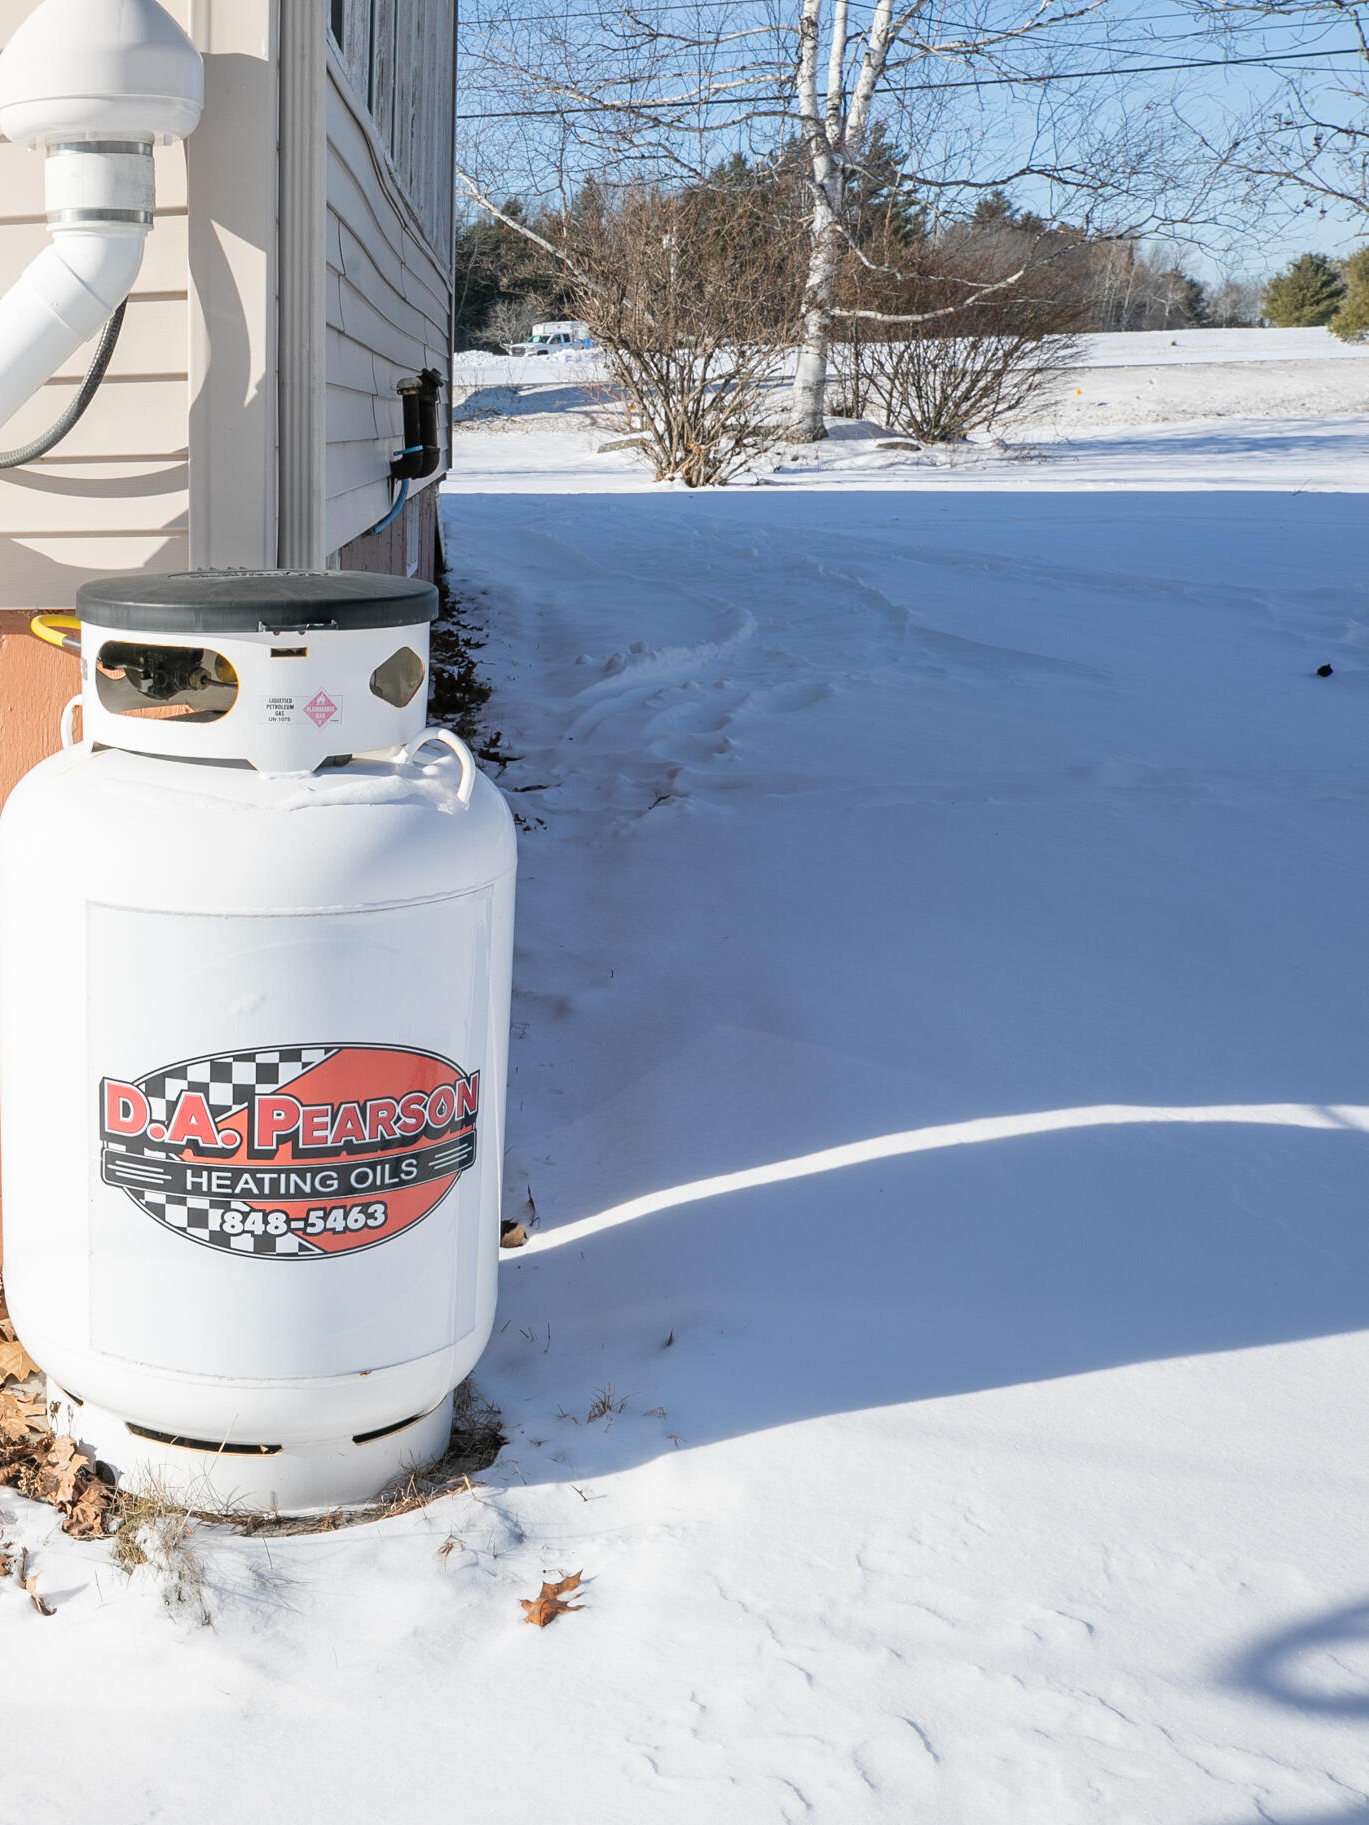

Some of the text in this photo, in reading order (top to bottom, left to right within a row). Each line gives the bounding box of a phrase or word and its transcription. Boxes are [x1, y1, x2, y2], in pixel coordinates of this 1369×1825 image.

[100, 1071, 480, 1150] D.A. PEARSON
[186, 1158, 418, 1195] HEATING OILS
[222, 1203, 386, 1235] 848-5463
